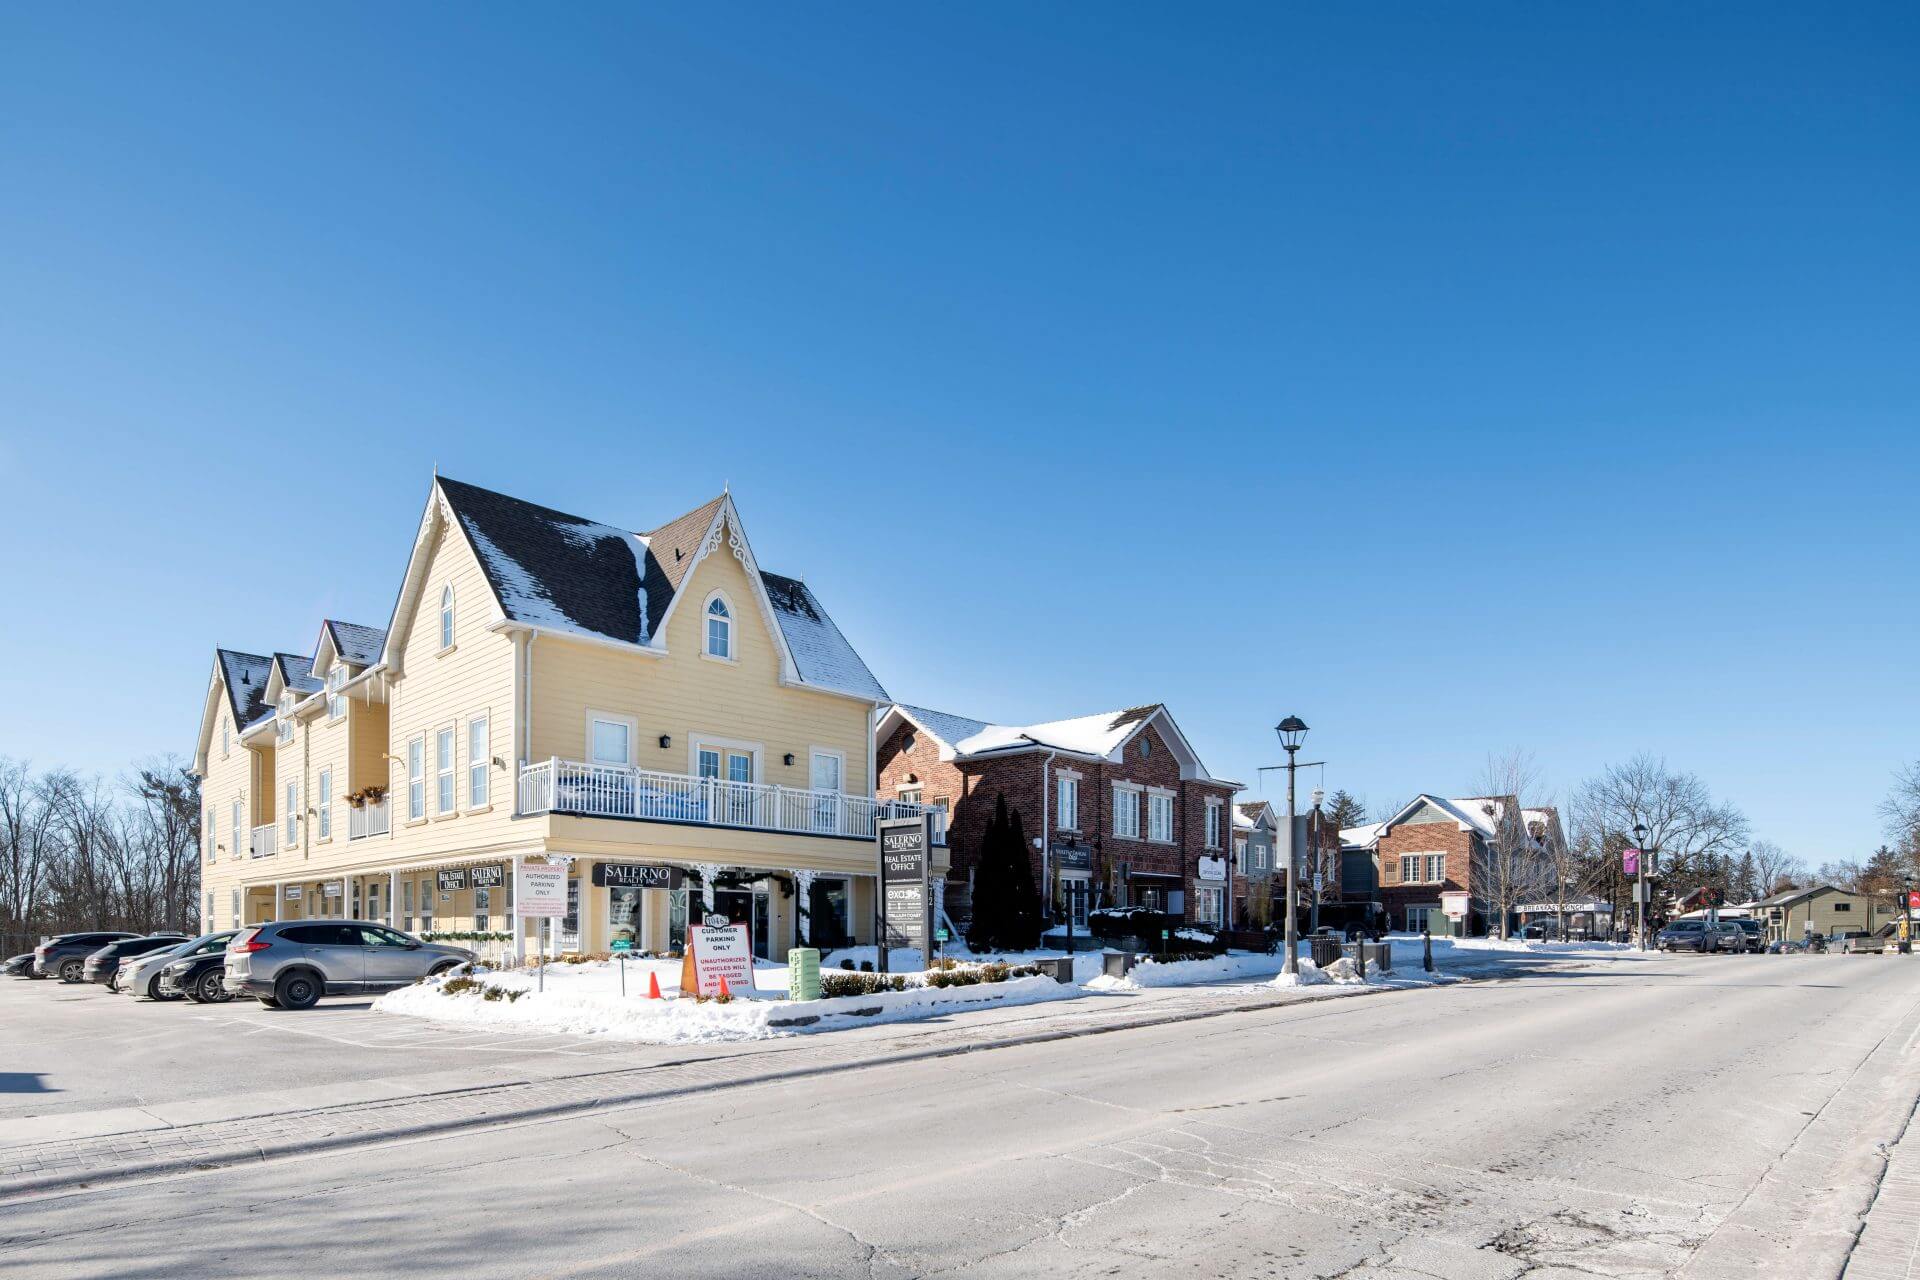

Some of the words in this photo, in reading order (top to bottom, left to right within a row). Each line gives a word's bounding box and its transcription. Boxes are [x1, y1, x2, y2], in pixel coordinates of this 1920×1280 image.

[884, 835, 922, 846] SALERNO
[884, 855, 899, 863] REAL
[900, 854, 922, 862] ESTATE
[890, 862, 915, 871] OFFICE
[472, 867, 501, 879] SALERNO
[606, 865, 669, 880] SALERNO
[707, 917, 729, 925] 10462
